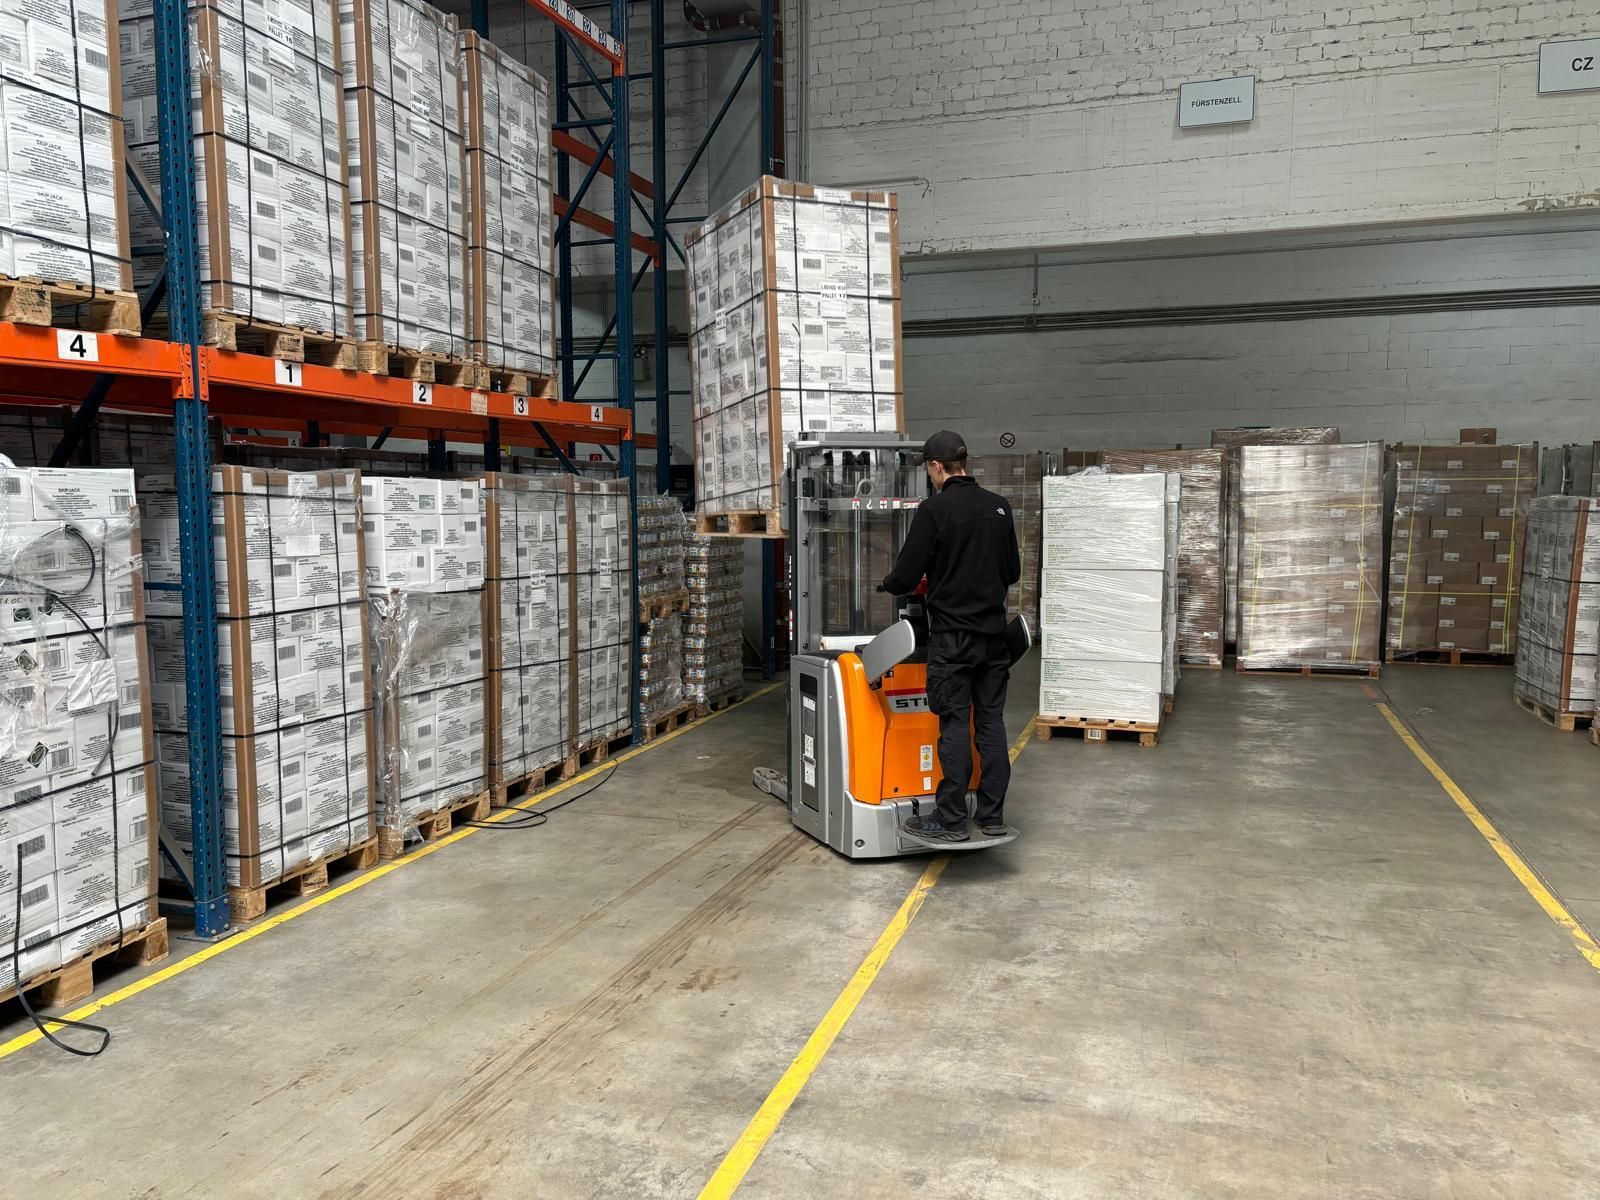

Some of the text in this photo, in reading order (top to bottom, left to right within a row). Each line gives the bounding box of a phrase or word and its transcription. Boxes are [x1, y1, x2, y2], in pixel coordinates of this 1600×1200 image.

[583, 18, 590, 36] 32
[600, 30, 606, 48] 34
[1571, 56, 1594, 71] CZ
[1191, 96, 1242, 108] FÜRSTENZELL
[70, 334, 86, 358] 4
[286, 364, 293, 382] 1
[418, 384, 426, 402] 2
[518, 398, 524, 413] 3
[594, 408, 600, 420] 4
[896, 697, 928, 708] STI
